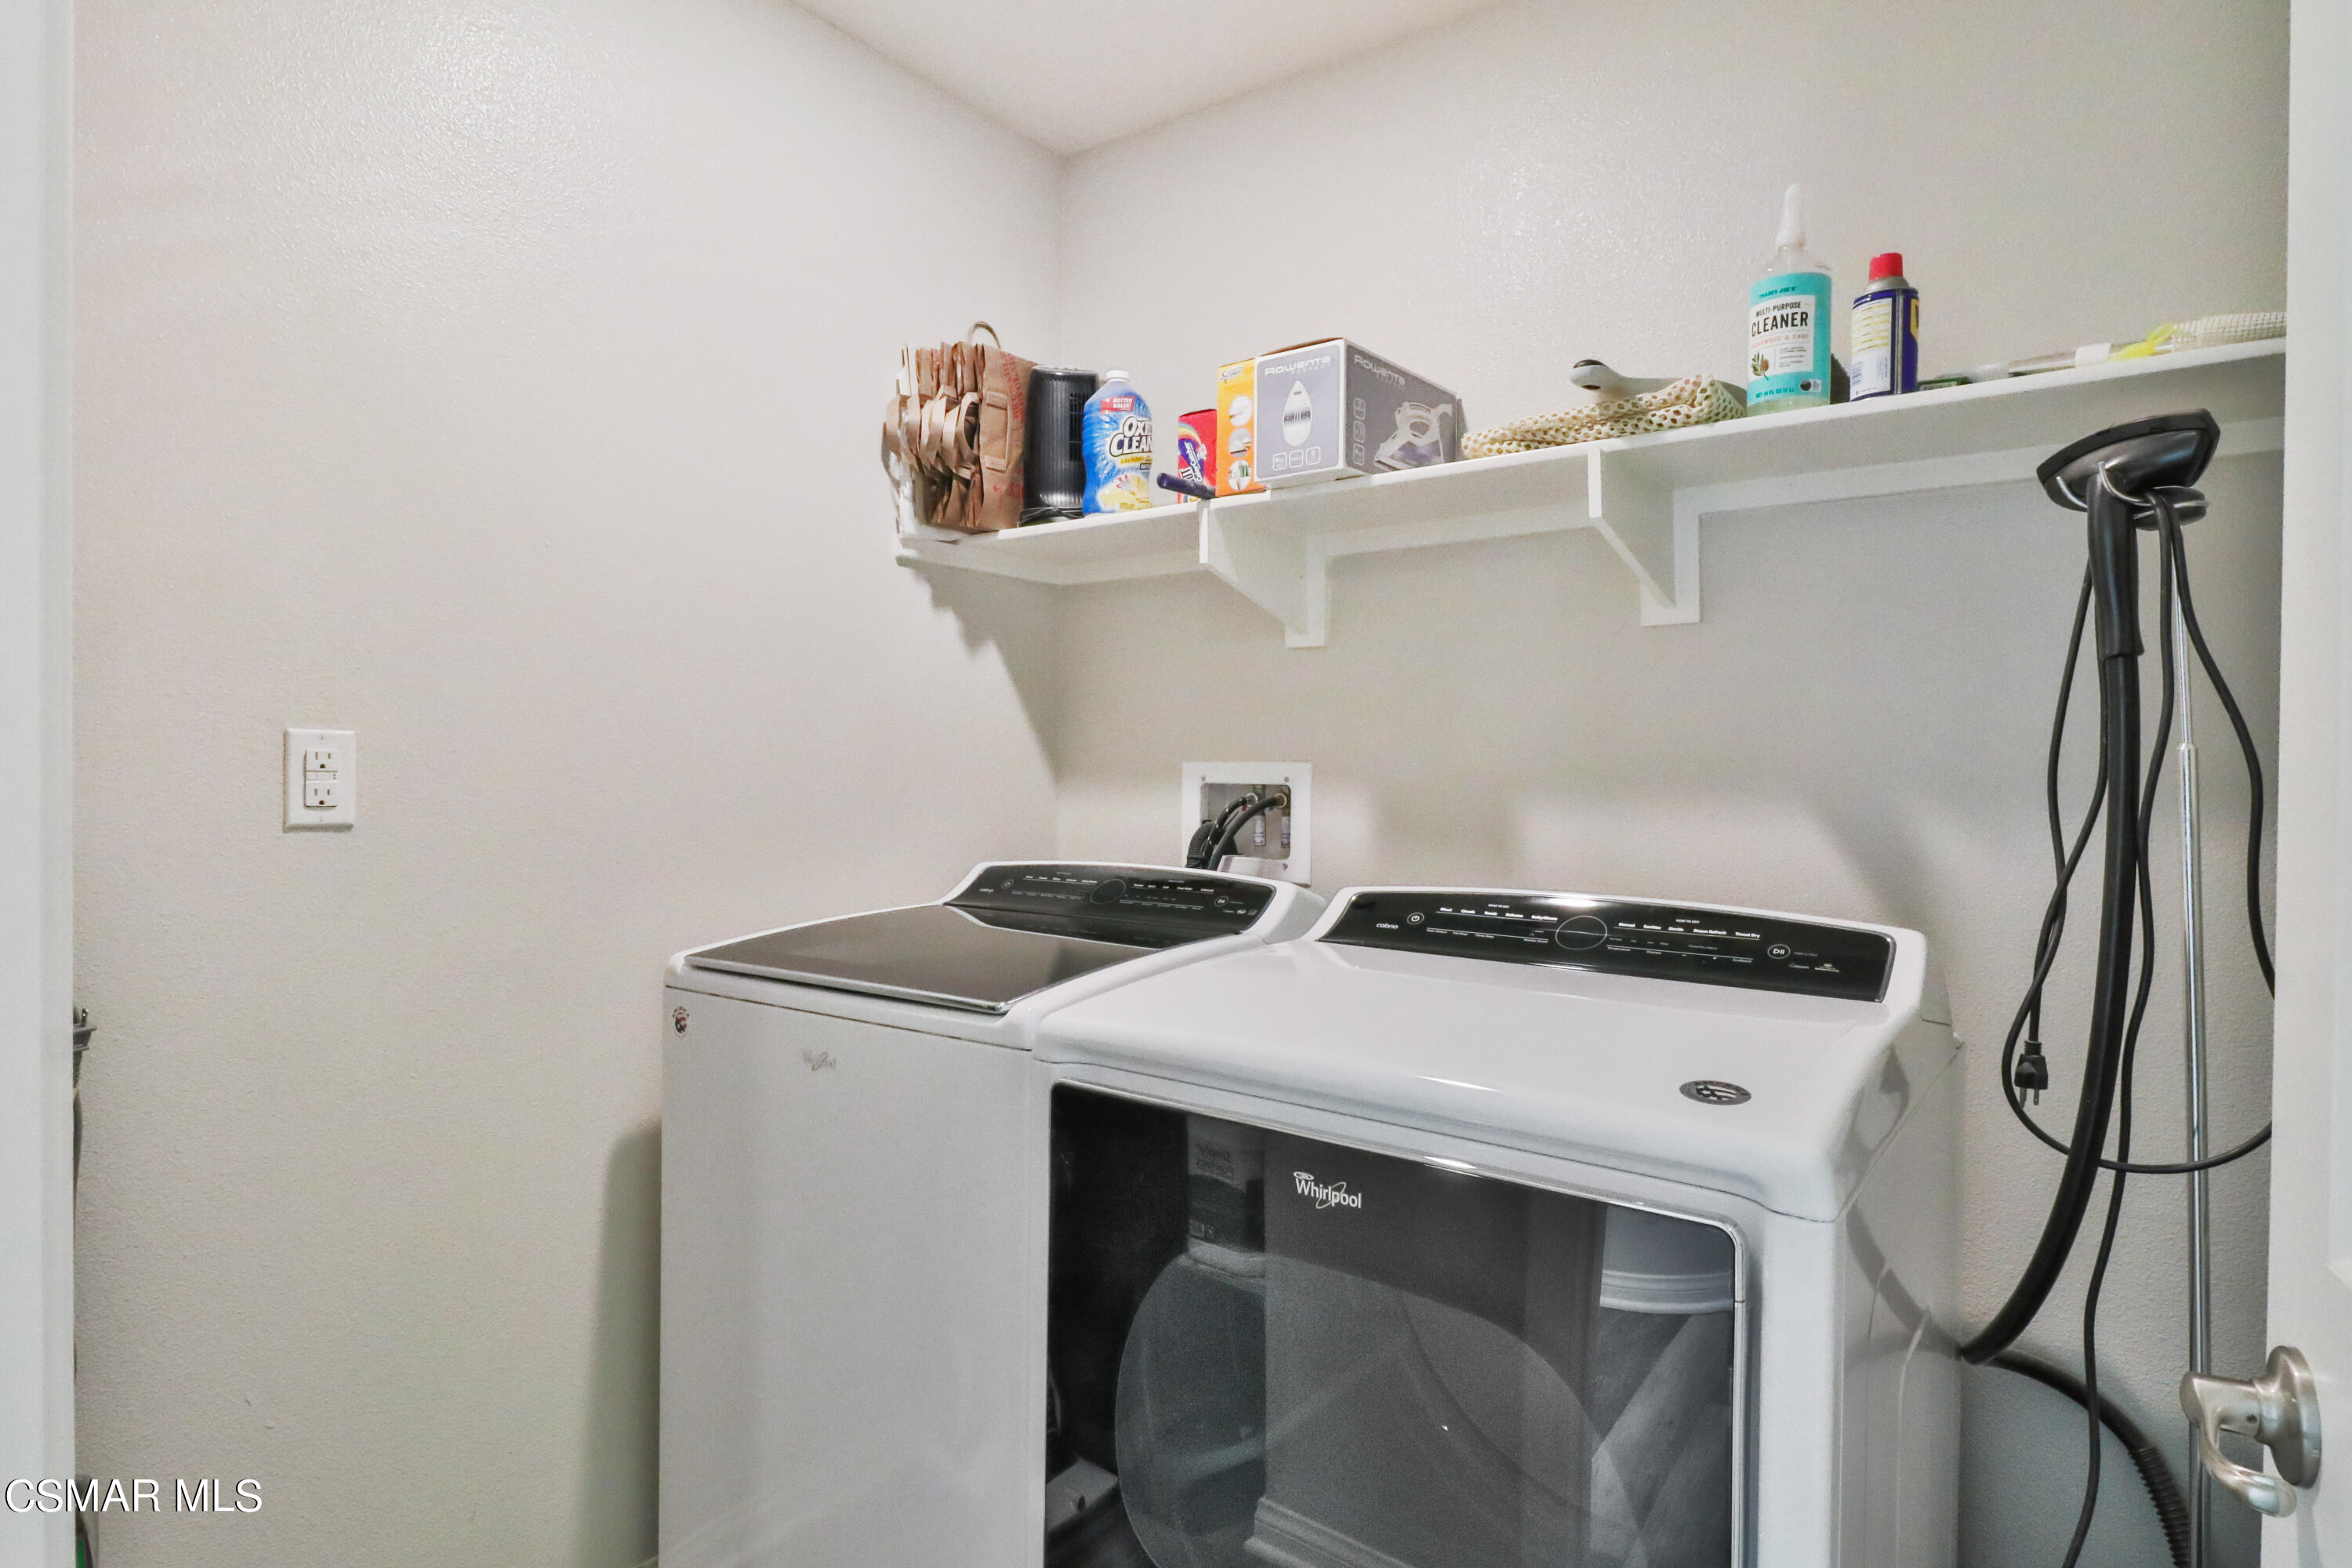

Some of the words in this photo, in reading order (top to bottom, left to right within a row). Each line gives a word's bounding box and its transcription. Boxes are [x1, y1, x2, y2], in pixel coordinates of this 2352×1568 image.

[1755, 301, 1802, 318] MULTI-PURPOSE
[1751, 311, 1809, 338] CLEANER
[1295, 1178, 1363, 1209] Whirlpool
